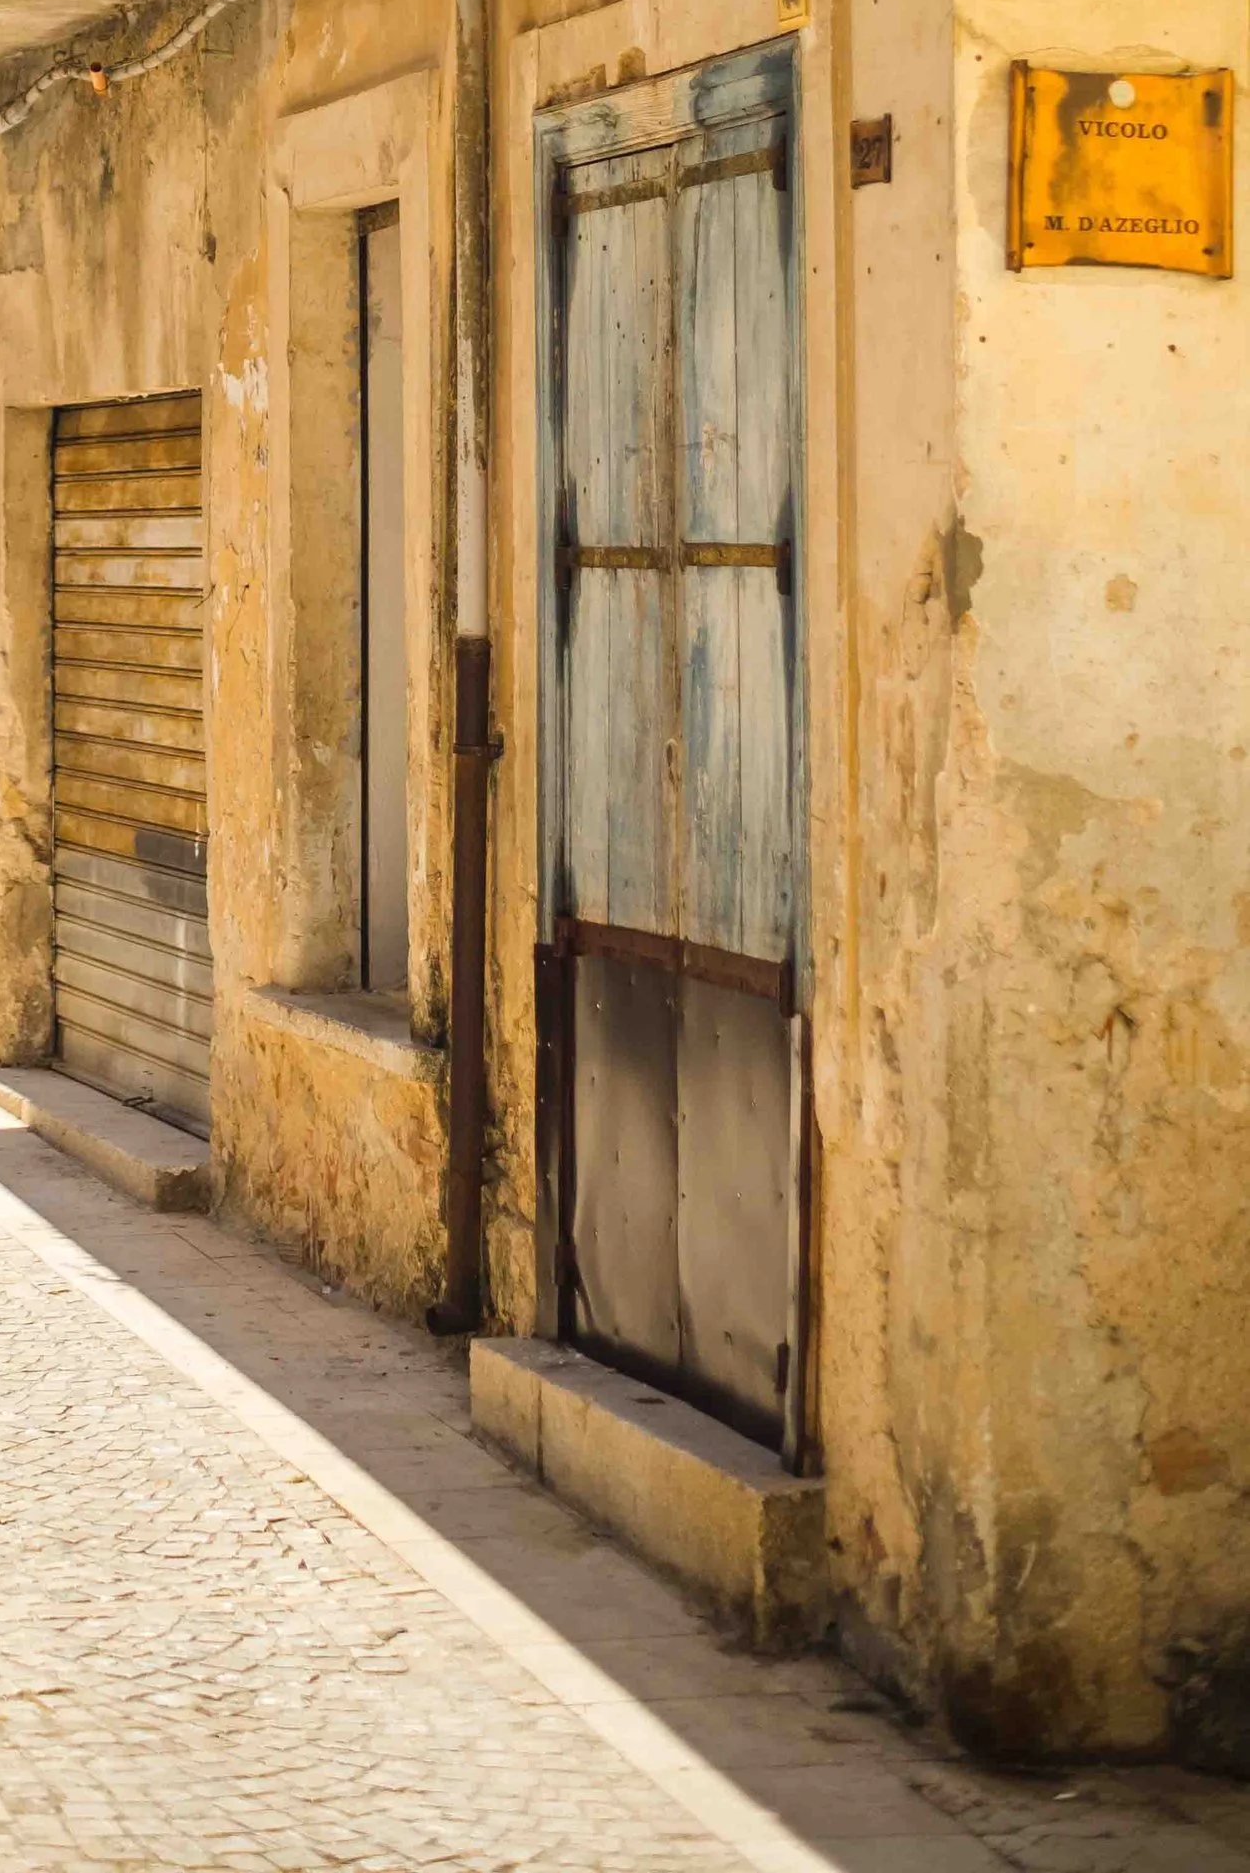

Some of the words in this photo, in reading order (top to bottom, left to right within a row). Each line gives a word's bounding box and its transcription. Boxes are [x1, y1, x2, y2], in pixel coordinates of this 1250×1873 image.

[1078, 120, 1168, 140] VICOLO
[856, 135, 883, 169] 27
[1044, 215, 1070, 231] M.
[1078, 216, 1200, 235] D'AZEGLIO
